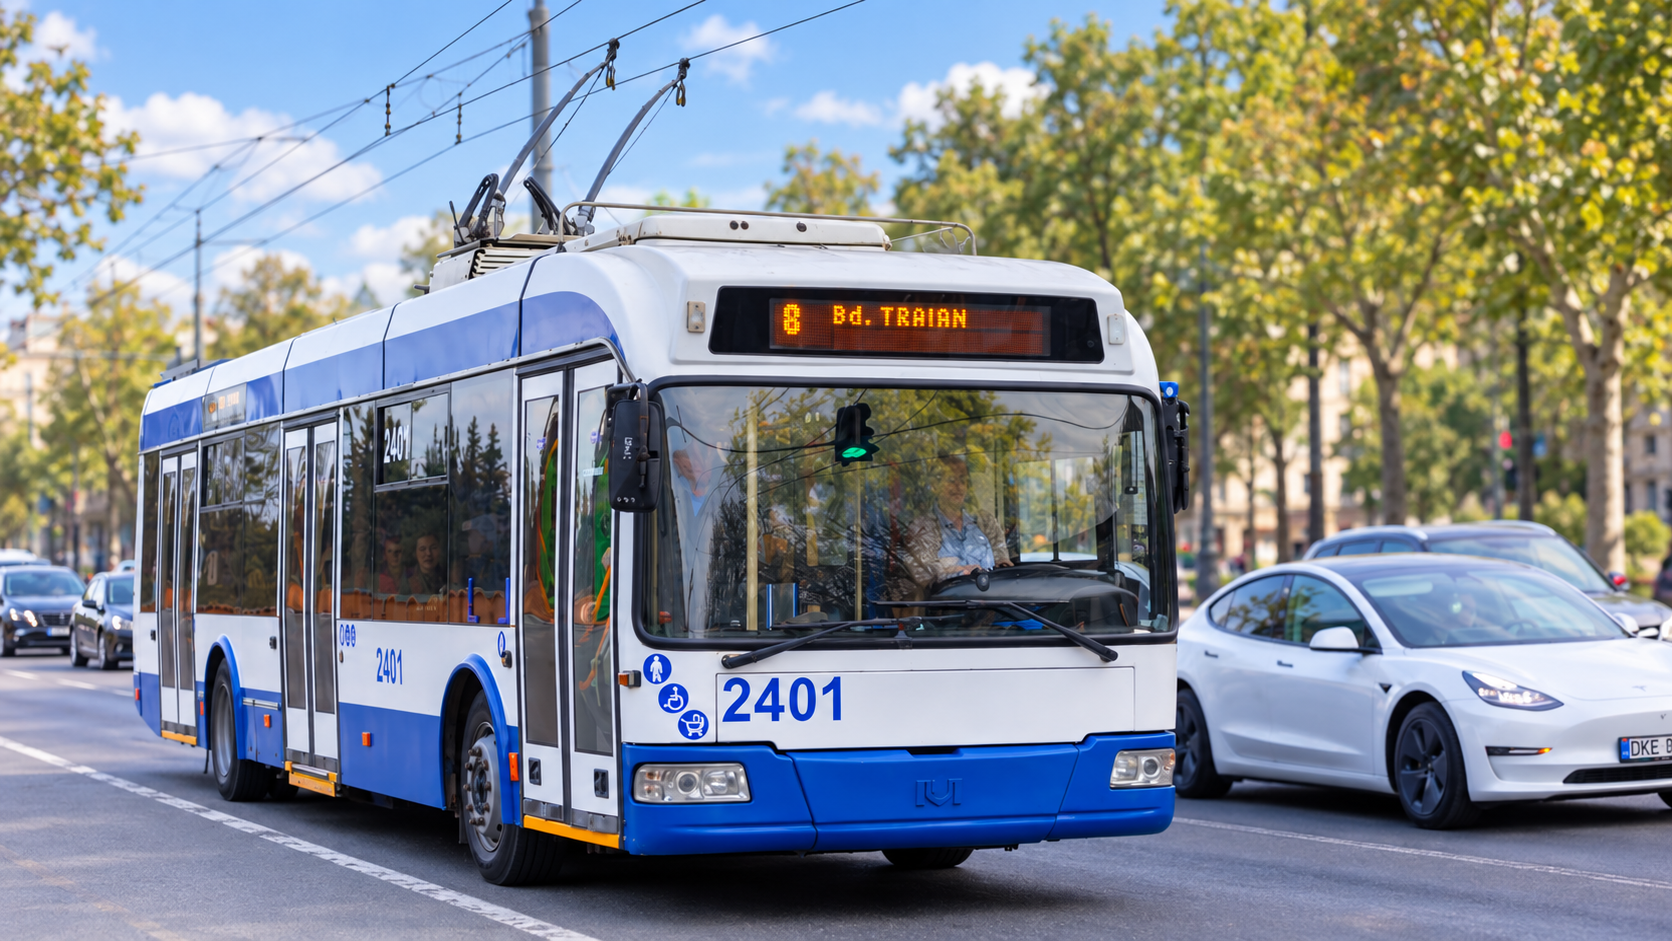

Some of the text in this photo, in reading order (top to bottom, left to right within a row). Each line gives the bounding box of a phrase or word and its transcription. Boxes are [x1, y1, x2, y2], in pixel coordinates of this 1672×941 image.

[783, 303, 801, 335] 8
[833, 305, 967, 329] Bd. TRAIAN
[383, 425, 410, 464] 2401
[376, 647, 403, 685] 2401
[722, 676, 842, 722] 2401
[1631, 739, 1660, 757] DKE
